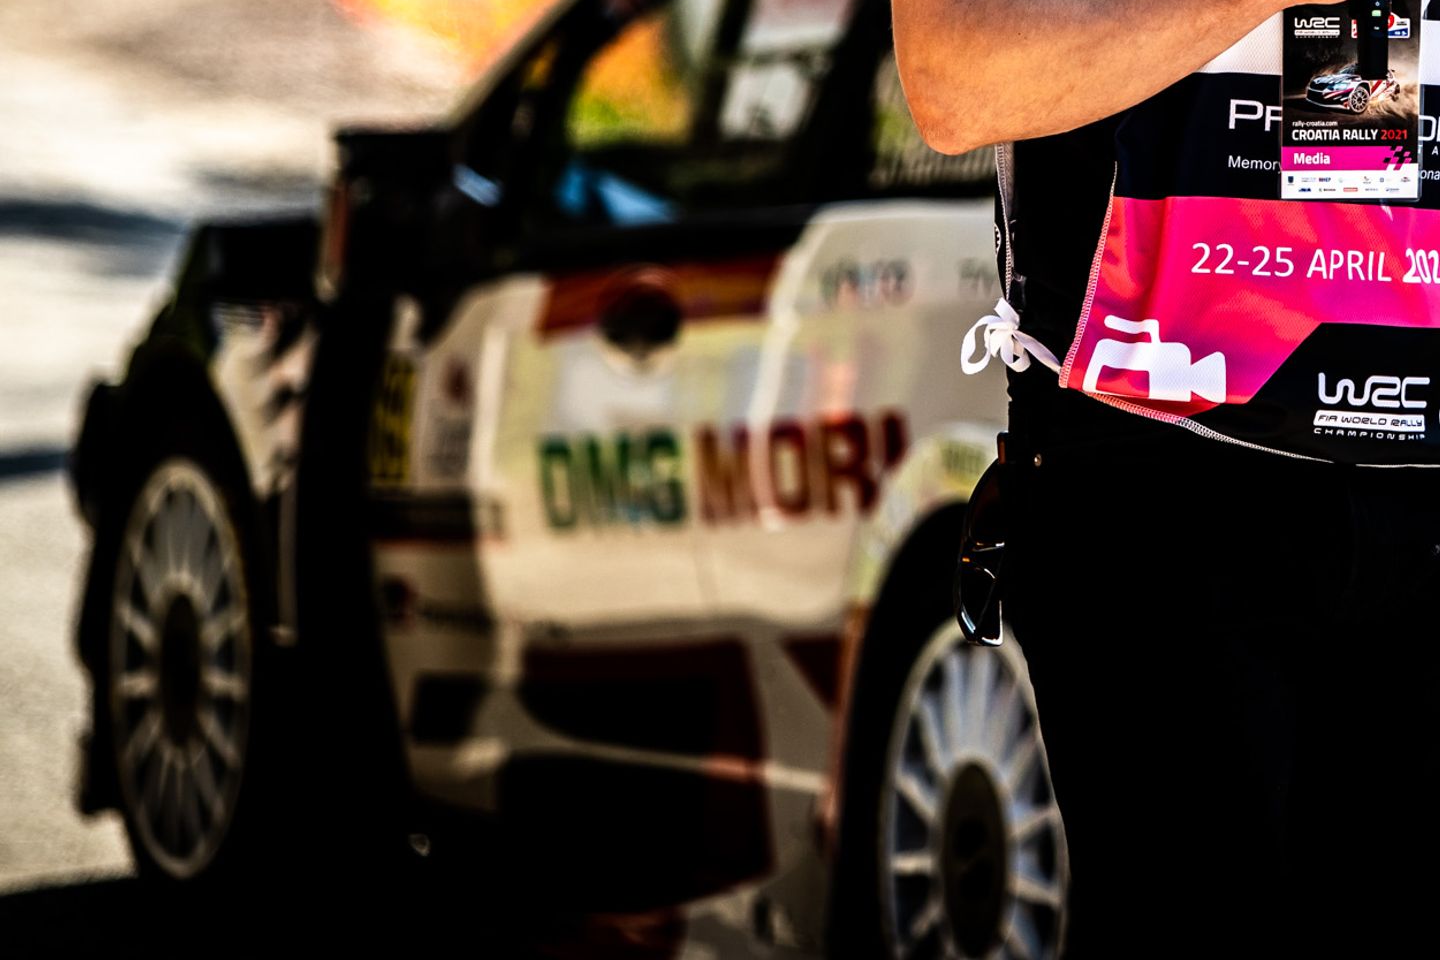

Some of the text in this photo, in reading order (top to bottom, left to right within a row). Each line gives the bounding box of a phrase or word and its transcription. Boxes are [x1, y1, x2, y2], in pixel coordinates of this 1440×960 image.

[1294, 16, 1340, 28] WRC
[1292, 129, 1408, 141] CROATIA RALLY 2021
[1293, 152, 1331, 165] Media
[1191, 242, 1295, 278] 22-25
[1306, 248, 1392, 282] APRIL
[1318, 372, 1430, 408] WRC
[1317, 414, 1423, 428] FIA WORLD RALLY
[1313, 427, 1426, 441] CHAMPIONSHIP
[540, 428, 688, 529] DMG
